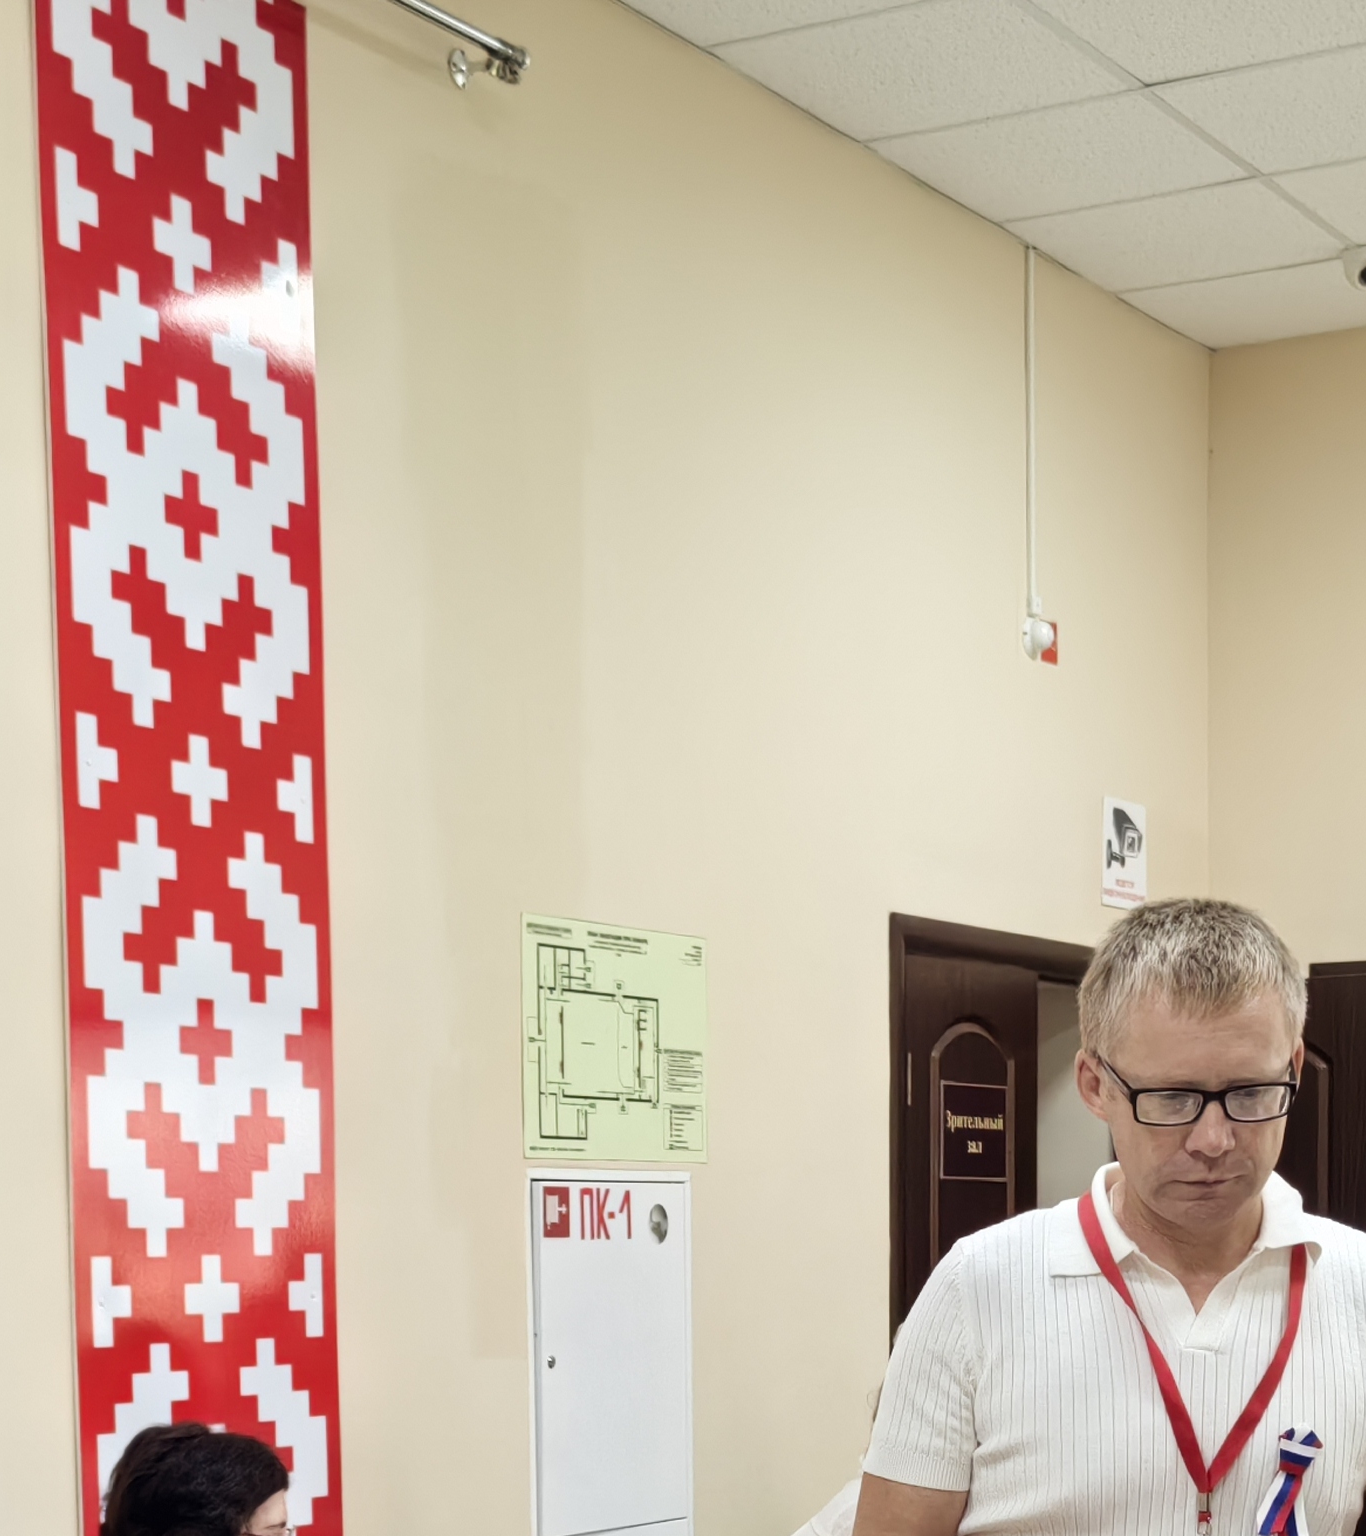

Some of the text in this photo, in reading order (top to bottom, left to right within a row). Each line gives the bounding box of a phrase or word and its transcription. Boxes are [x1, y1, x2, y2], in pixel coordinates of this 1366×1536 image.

[946, 1109, 1004, 1133] Зрительный
[967, 1140, 983, 1154] зал
[580, 1187, 632, 1241] ПК-1
